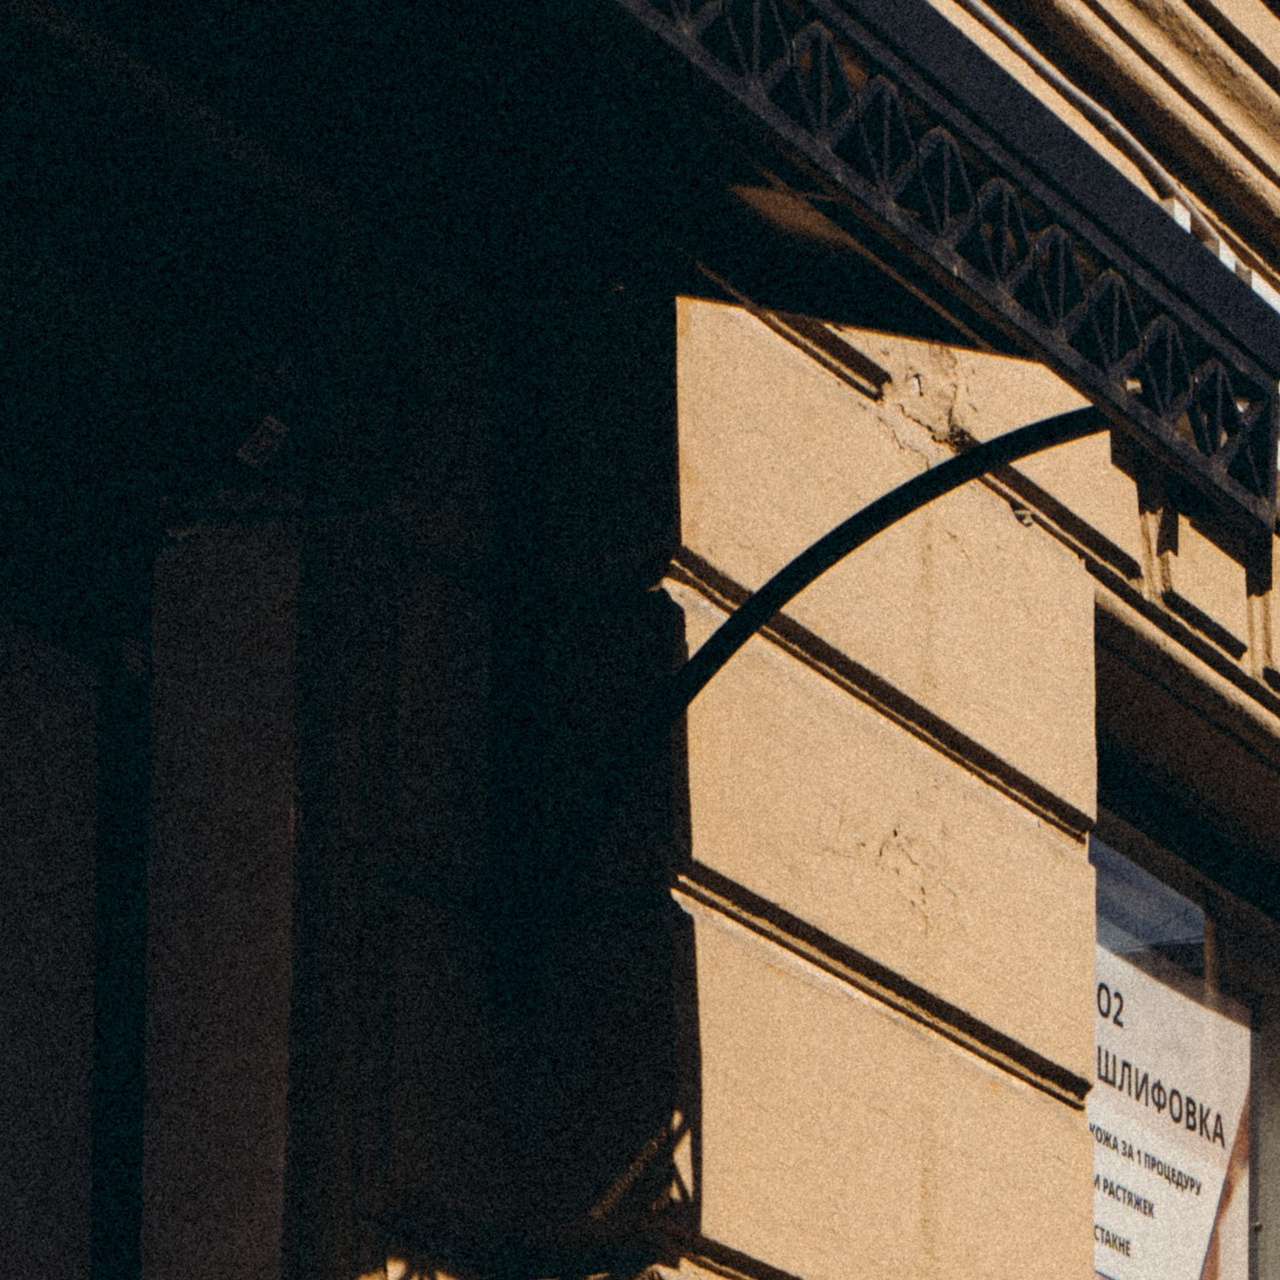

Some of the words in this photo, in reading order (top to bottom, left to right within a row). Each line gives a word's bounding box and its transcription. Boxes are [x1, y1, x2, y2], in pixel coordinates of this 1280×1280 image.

[1097, 1045, 1225, 1148] ШЛИФОВКА
[1121, 1140, 1134, 1161] ЗА
[1137, 1149, 1142, 1165] 1
[1144, 1152, 1202, 1196] ПРОЦЕДУРУ
[1103, 1178, 1155, 1219] РАСТЯЖЕК
